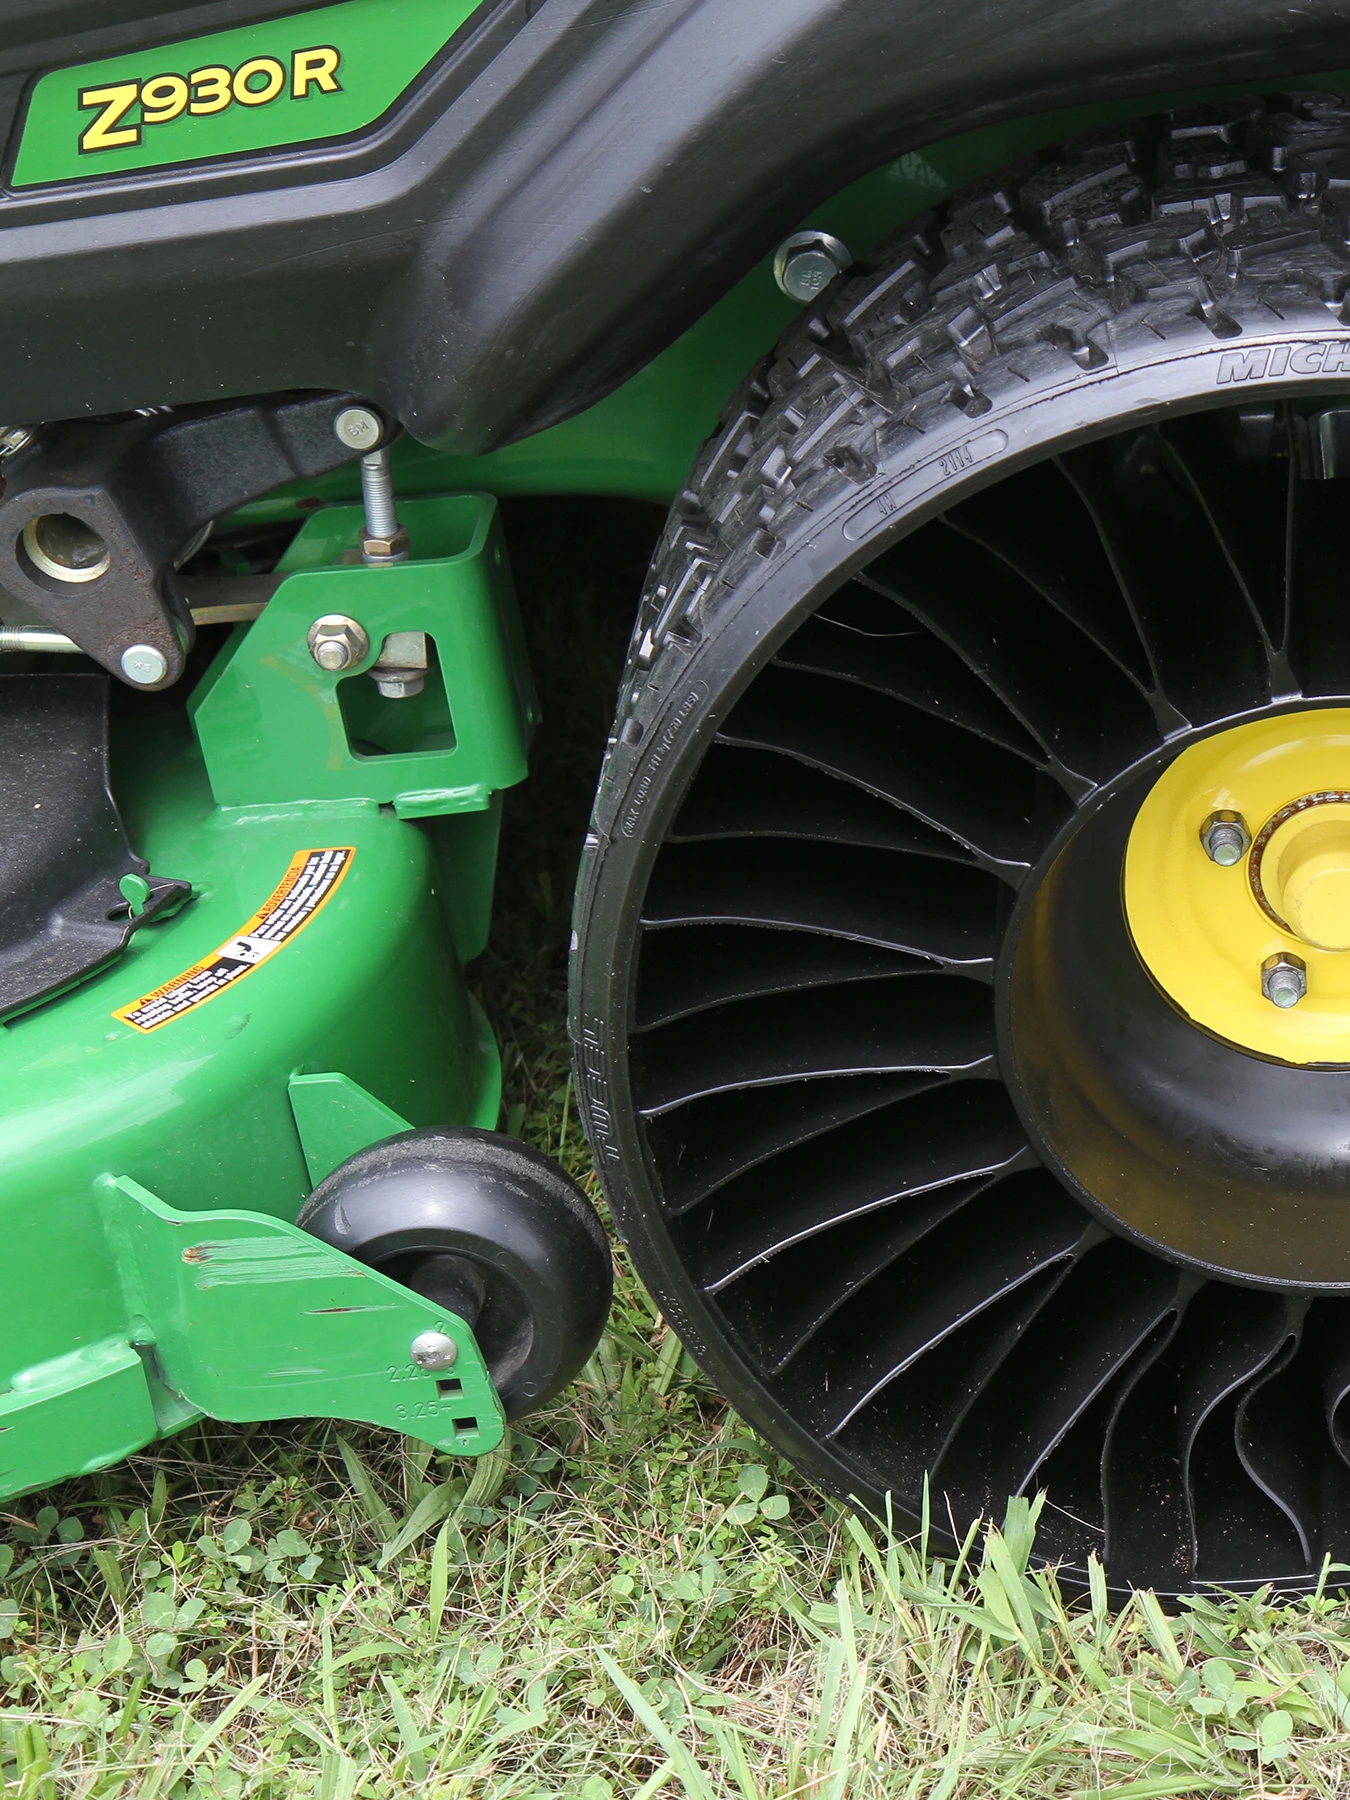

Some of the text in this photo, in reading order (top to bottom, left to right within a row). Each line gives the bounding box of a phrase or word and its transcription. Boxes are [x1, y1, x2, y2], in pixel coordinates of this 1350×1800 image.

[79, 46, 341, 153] Z930R
[265, 866, 303, 913] ADVERTENCIA
[150, 965, 205, 998] WARNING
[582, 1017, 620, 1166] TWEEL
